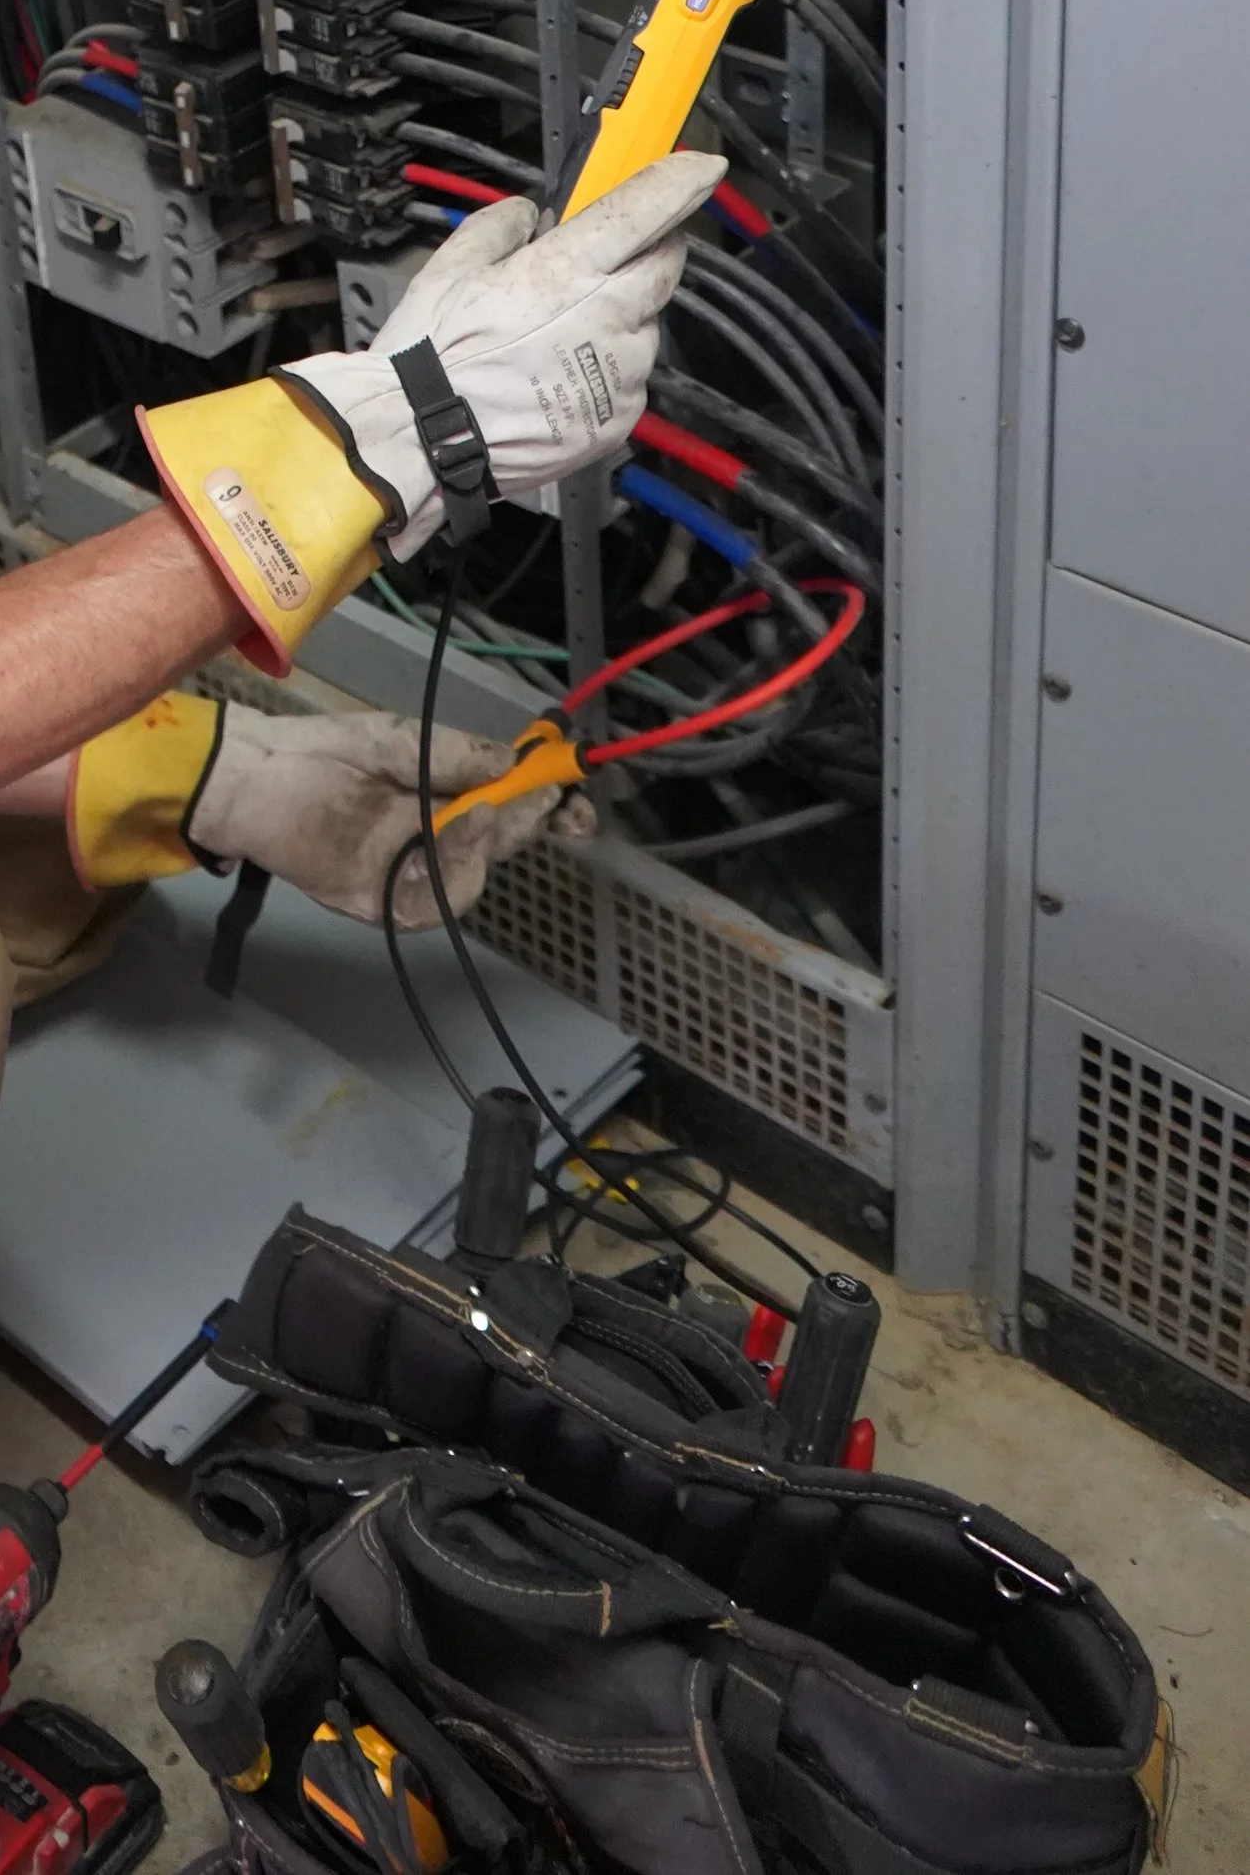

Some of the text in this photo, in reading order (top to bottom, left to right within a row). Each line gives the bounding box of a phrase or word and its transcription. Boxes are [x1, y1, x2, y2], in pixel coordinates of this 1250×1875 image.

[553, 344, 578, 387] LEATHER
[576, 346, 611, 421] SALISBURY
[258, 519, 300, 576] SALISBURY
